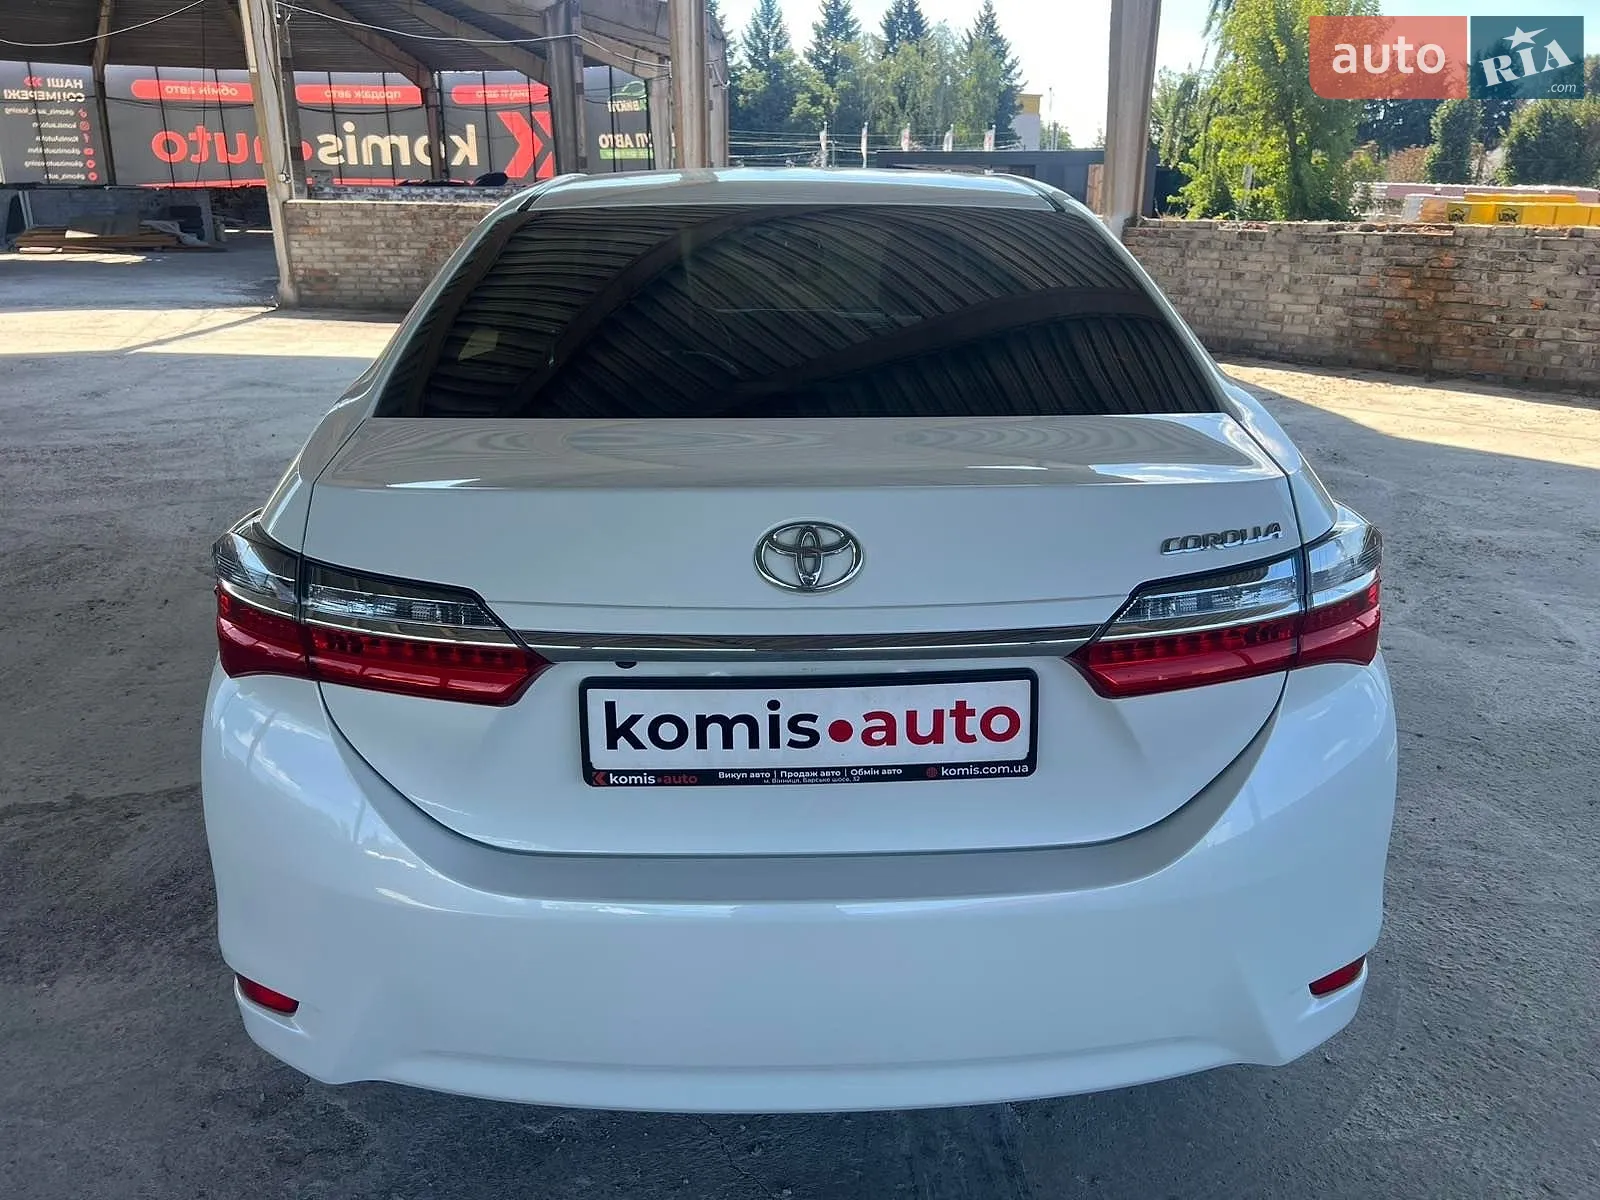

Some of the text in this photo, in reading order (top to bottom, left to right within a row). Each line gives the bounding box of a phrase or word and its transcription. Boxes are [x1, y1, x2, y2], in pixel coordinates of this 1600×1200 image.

[1160, 522, 1281, 555] COROLLA
[604, 699, 1022, 751] komis auto
[718, 771, 748, 779] Викуп
[780, 770, 818, 779] Продаж
[820, 769, 841, 777] авто
[850, 767, 880, 776] Обмін
[941, 764, 1029, 777] komis.com.ua
[609, 772, 698, 784] komis auto
